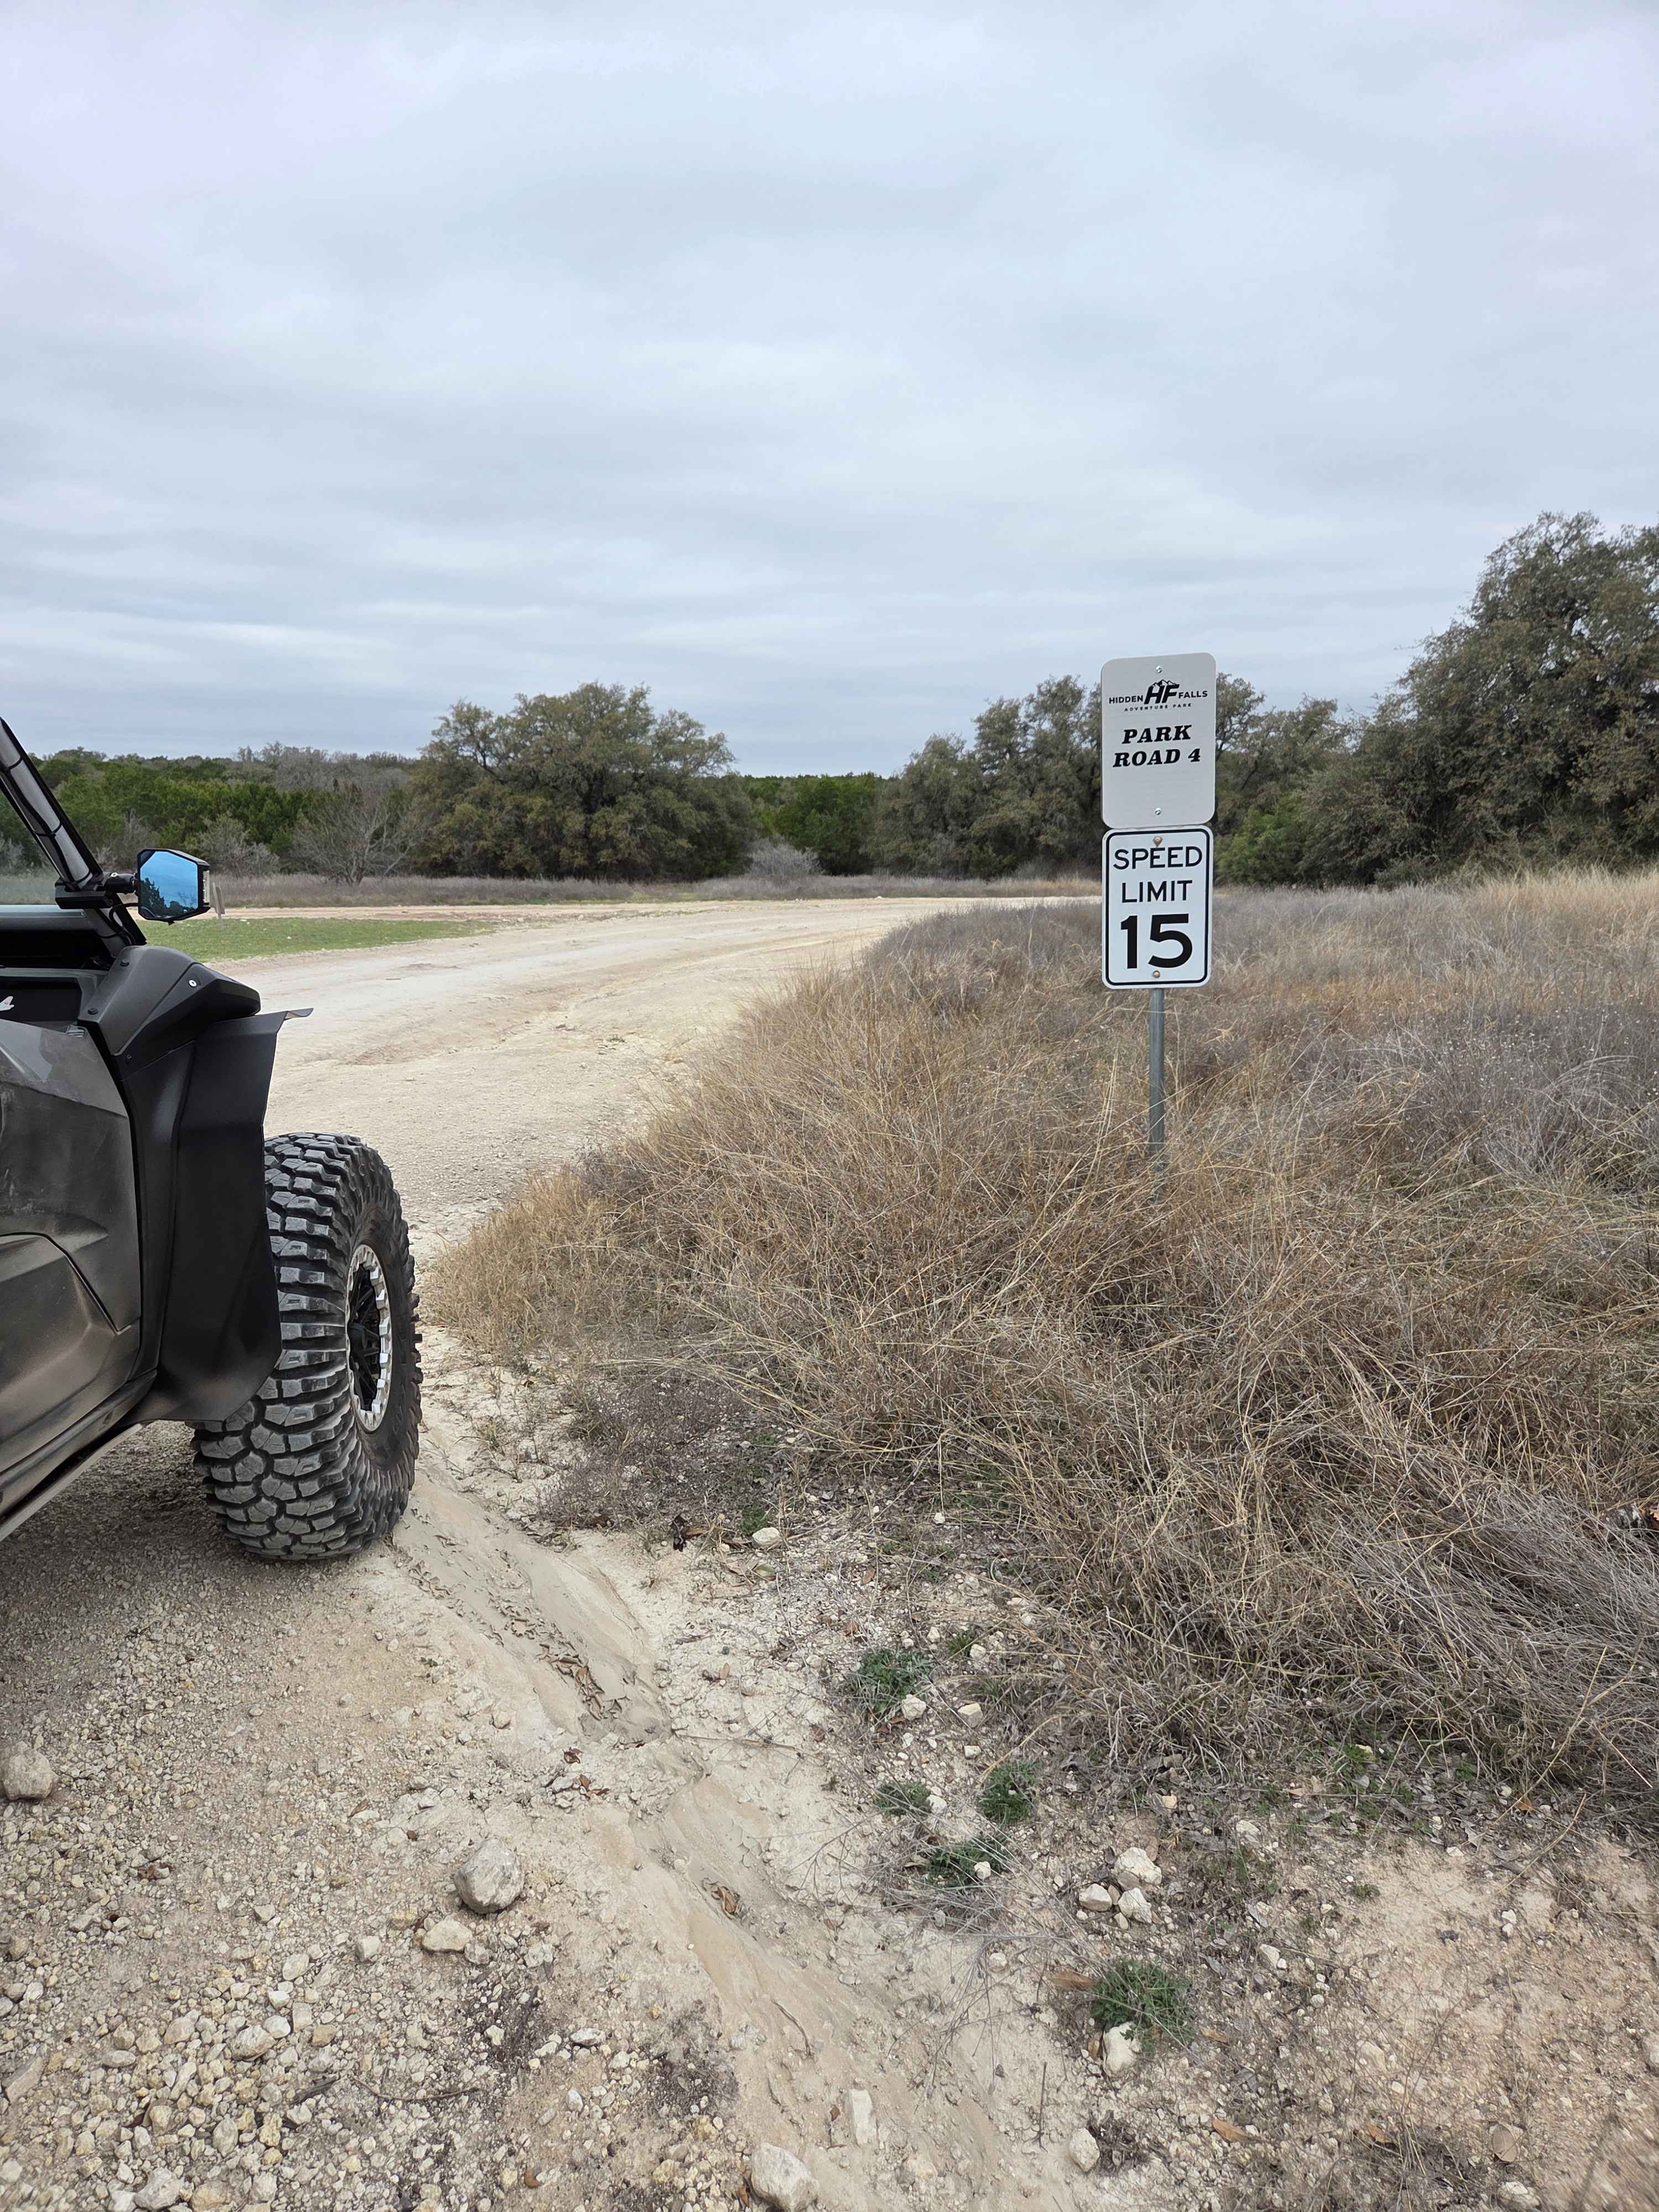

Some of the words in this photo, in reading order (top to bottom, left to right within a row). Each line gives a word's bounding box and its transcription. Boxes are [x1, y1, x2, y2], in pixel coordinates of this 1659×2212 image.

[1109, 695, 1143, 703] HIDDEN
[1121, 724, 1192, 744] PARK
[1113, 749, 1180, 767] ROAD
[1188, 748, 1201, 762] 4
[1113, 846, 1202, 869] SPEED
[1122, 880, 1192, 902] LIMIT
[1121, 914, 1192, 969] 15
